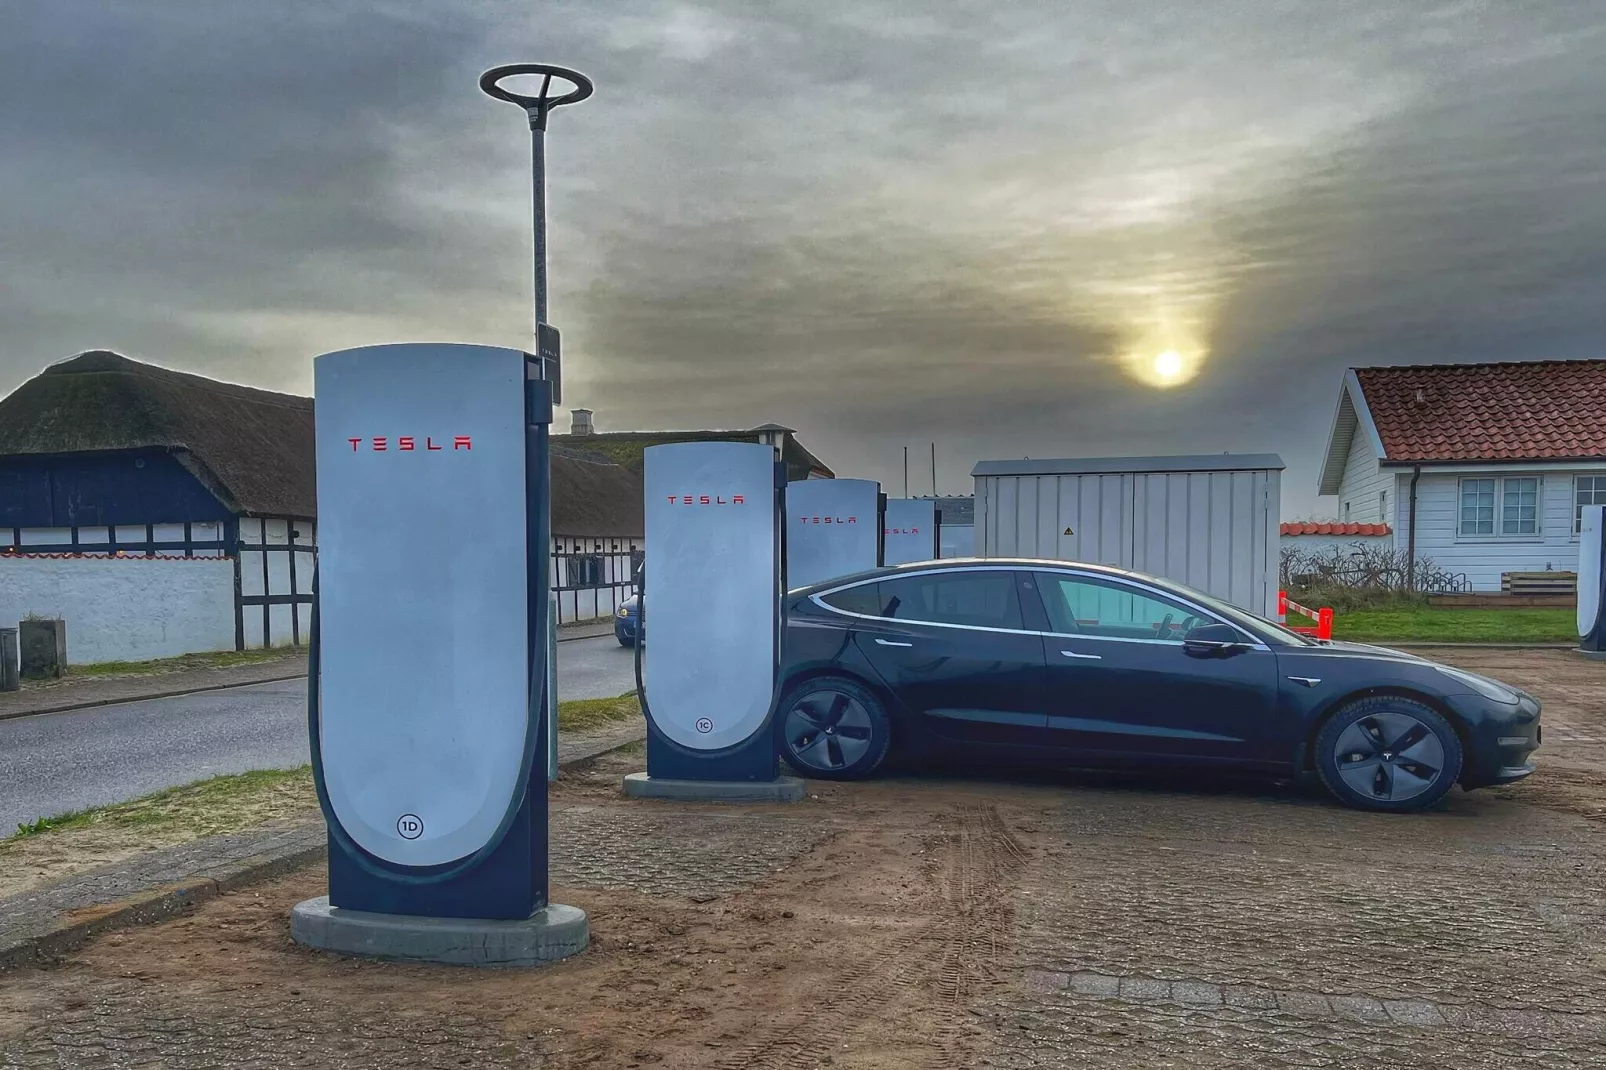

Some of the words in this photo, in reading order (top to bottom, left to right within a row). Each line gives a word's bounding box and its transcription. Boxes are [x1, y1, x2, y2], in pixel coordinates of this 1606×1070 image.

[348, 436, 471, 452] TESLA
[667, 495, 744, 505] TESLA
[402, 821, 418, 832] 1D
